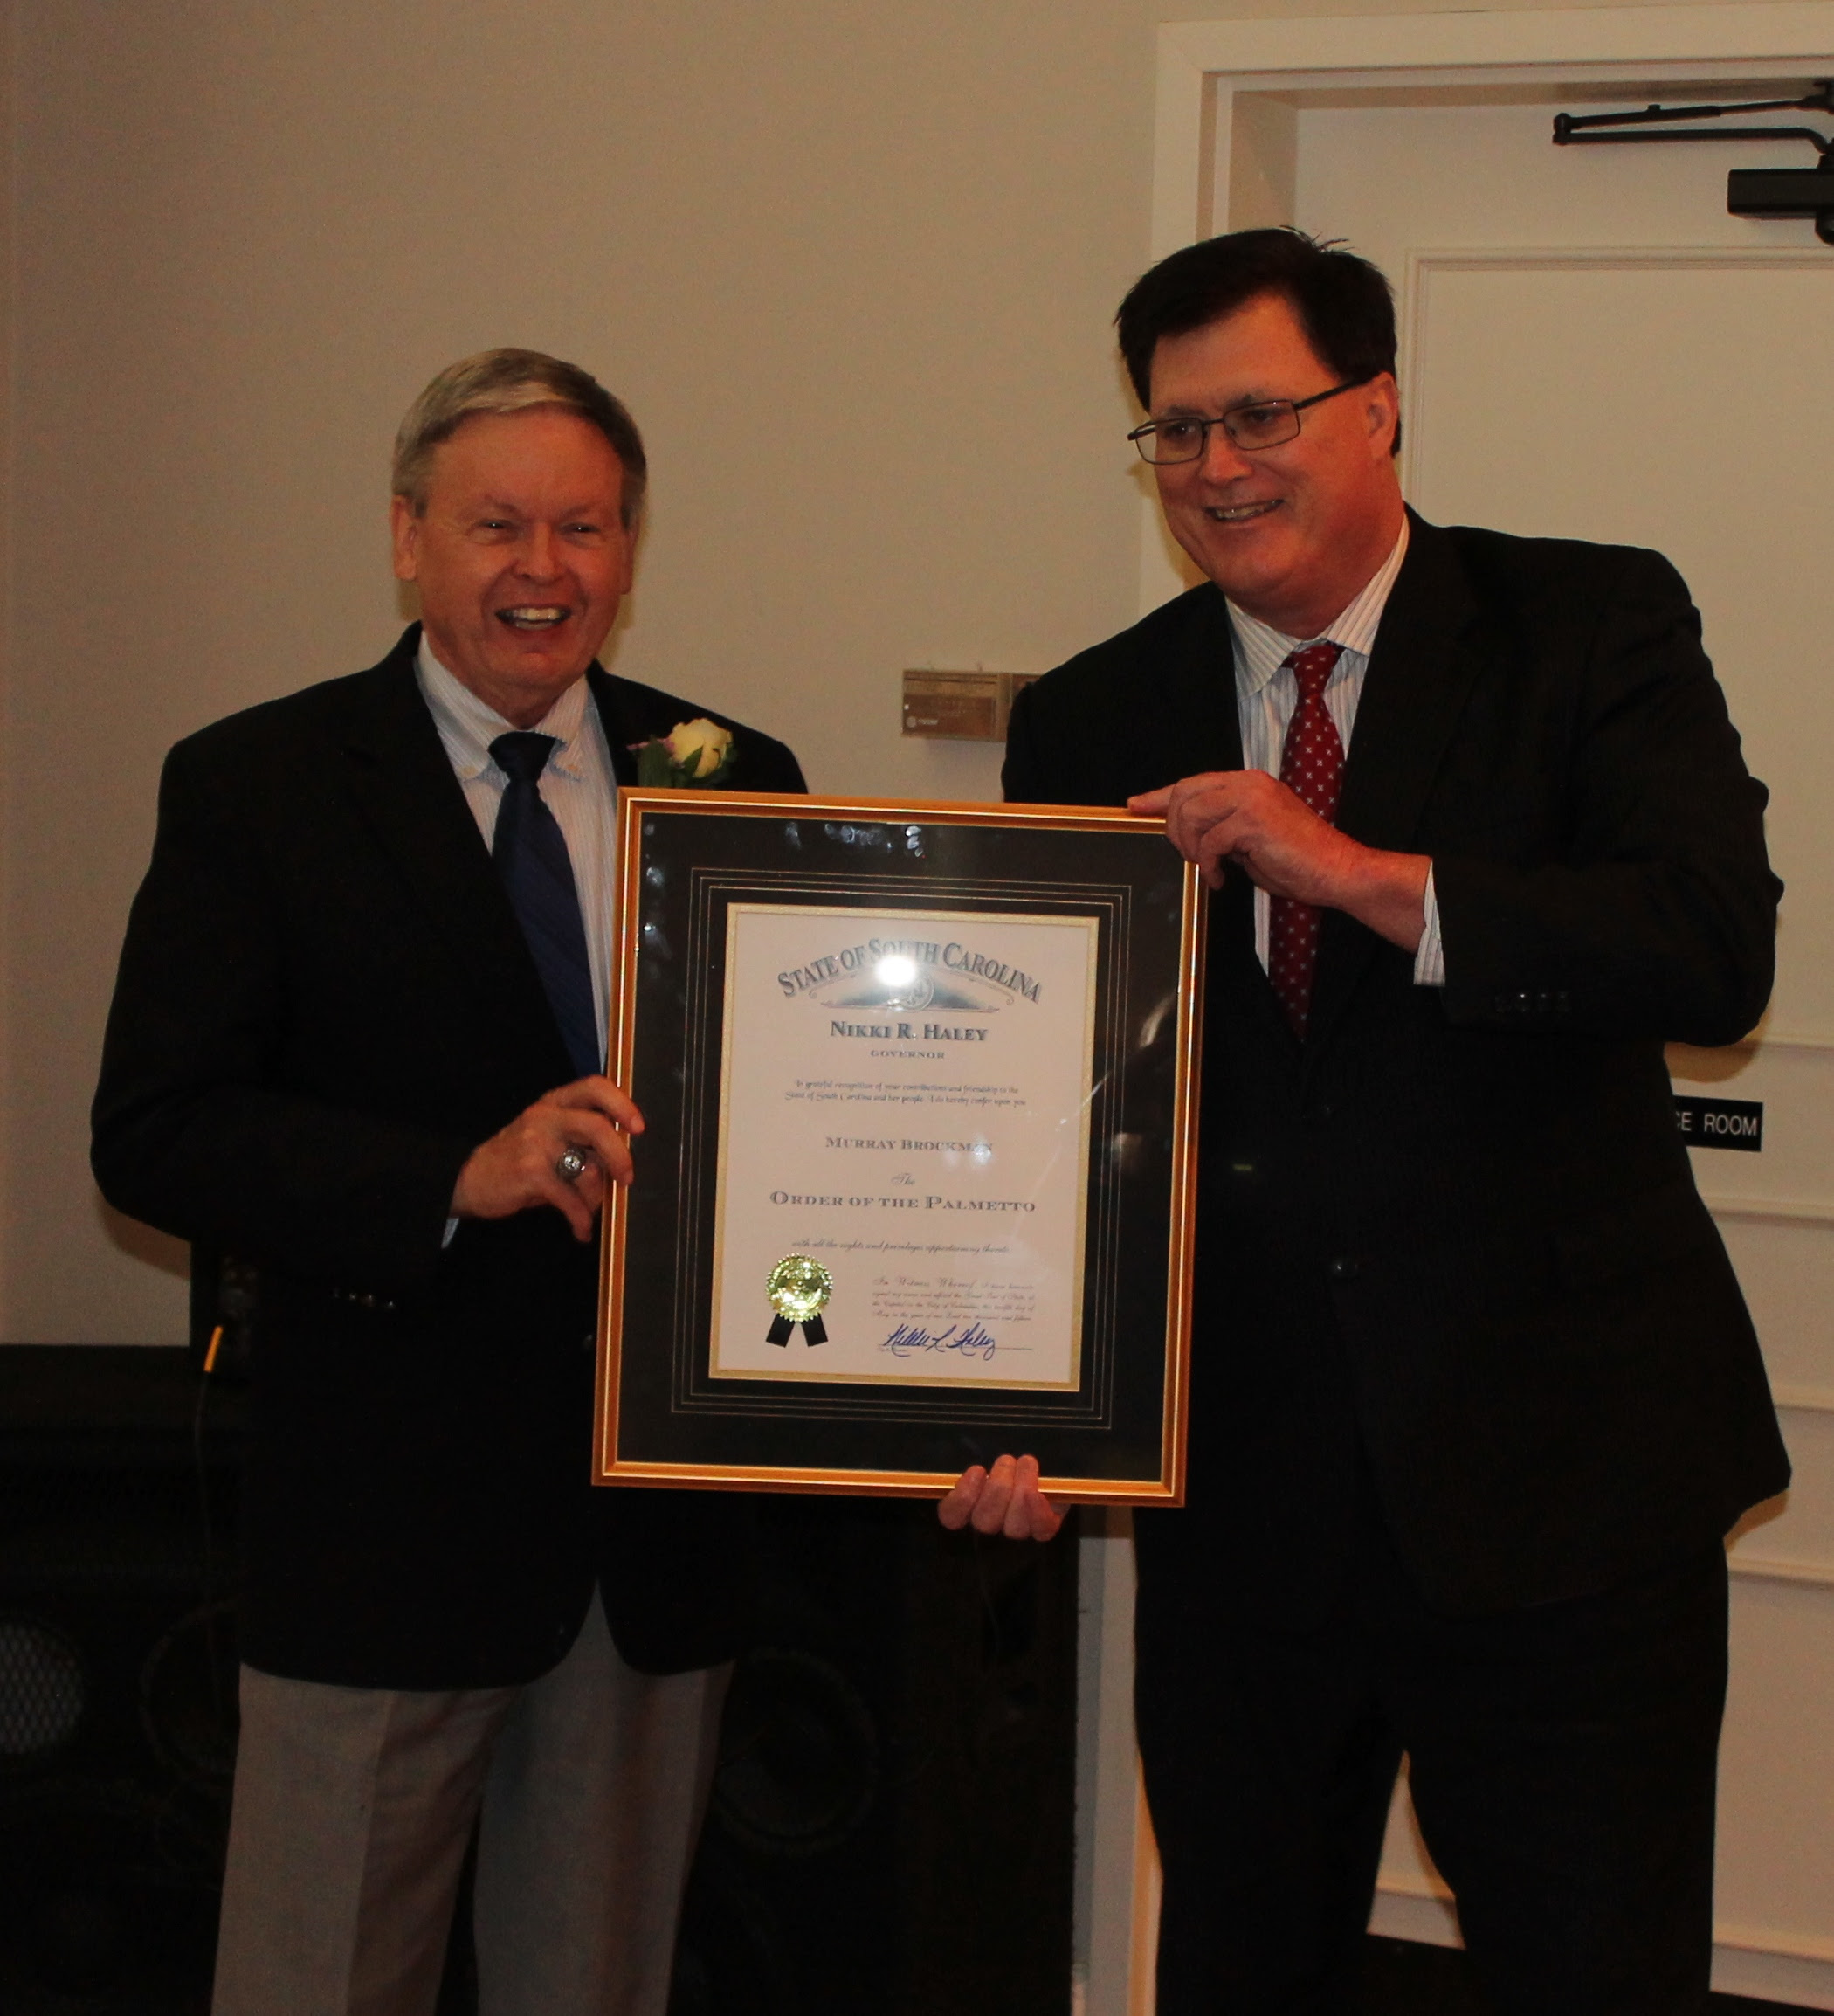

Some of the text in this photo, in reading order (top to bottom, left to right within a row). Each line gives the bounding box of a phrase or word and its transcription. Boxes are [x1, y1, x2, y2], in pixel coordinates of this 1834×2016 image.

[777, 955, 838, 998] STATE
[840, 946, 865, 970] OF
[943, 942, 1041, 1005] CAROLINA
[831, 1021, 892, 1039] NIKKI
[923, 1024, 988, 1041] HALEY
[870, 1050, 946, 1059] GOVERNOR
[1704, 1113, 1758, 1136] ROOM
[825, 1136, 897, 1150] MURRAY
[769, 1191, 1035, 1212] ORDER OF THE PALMETTO
